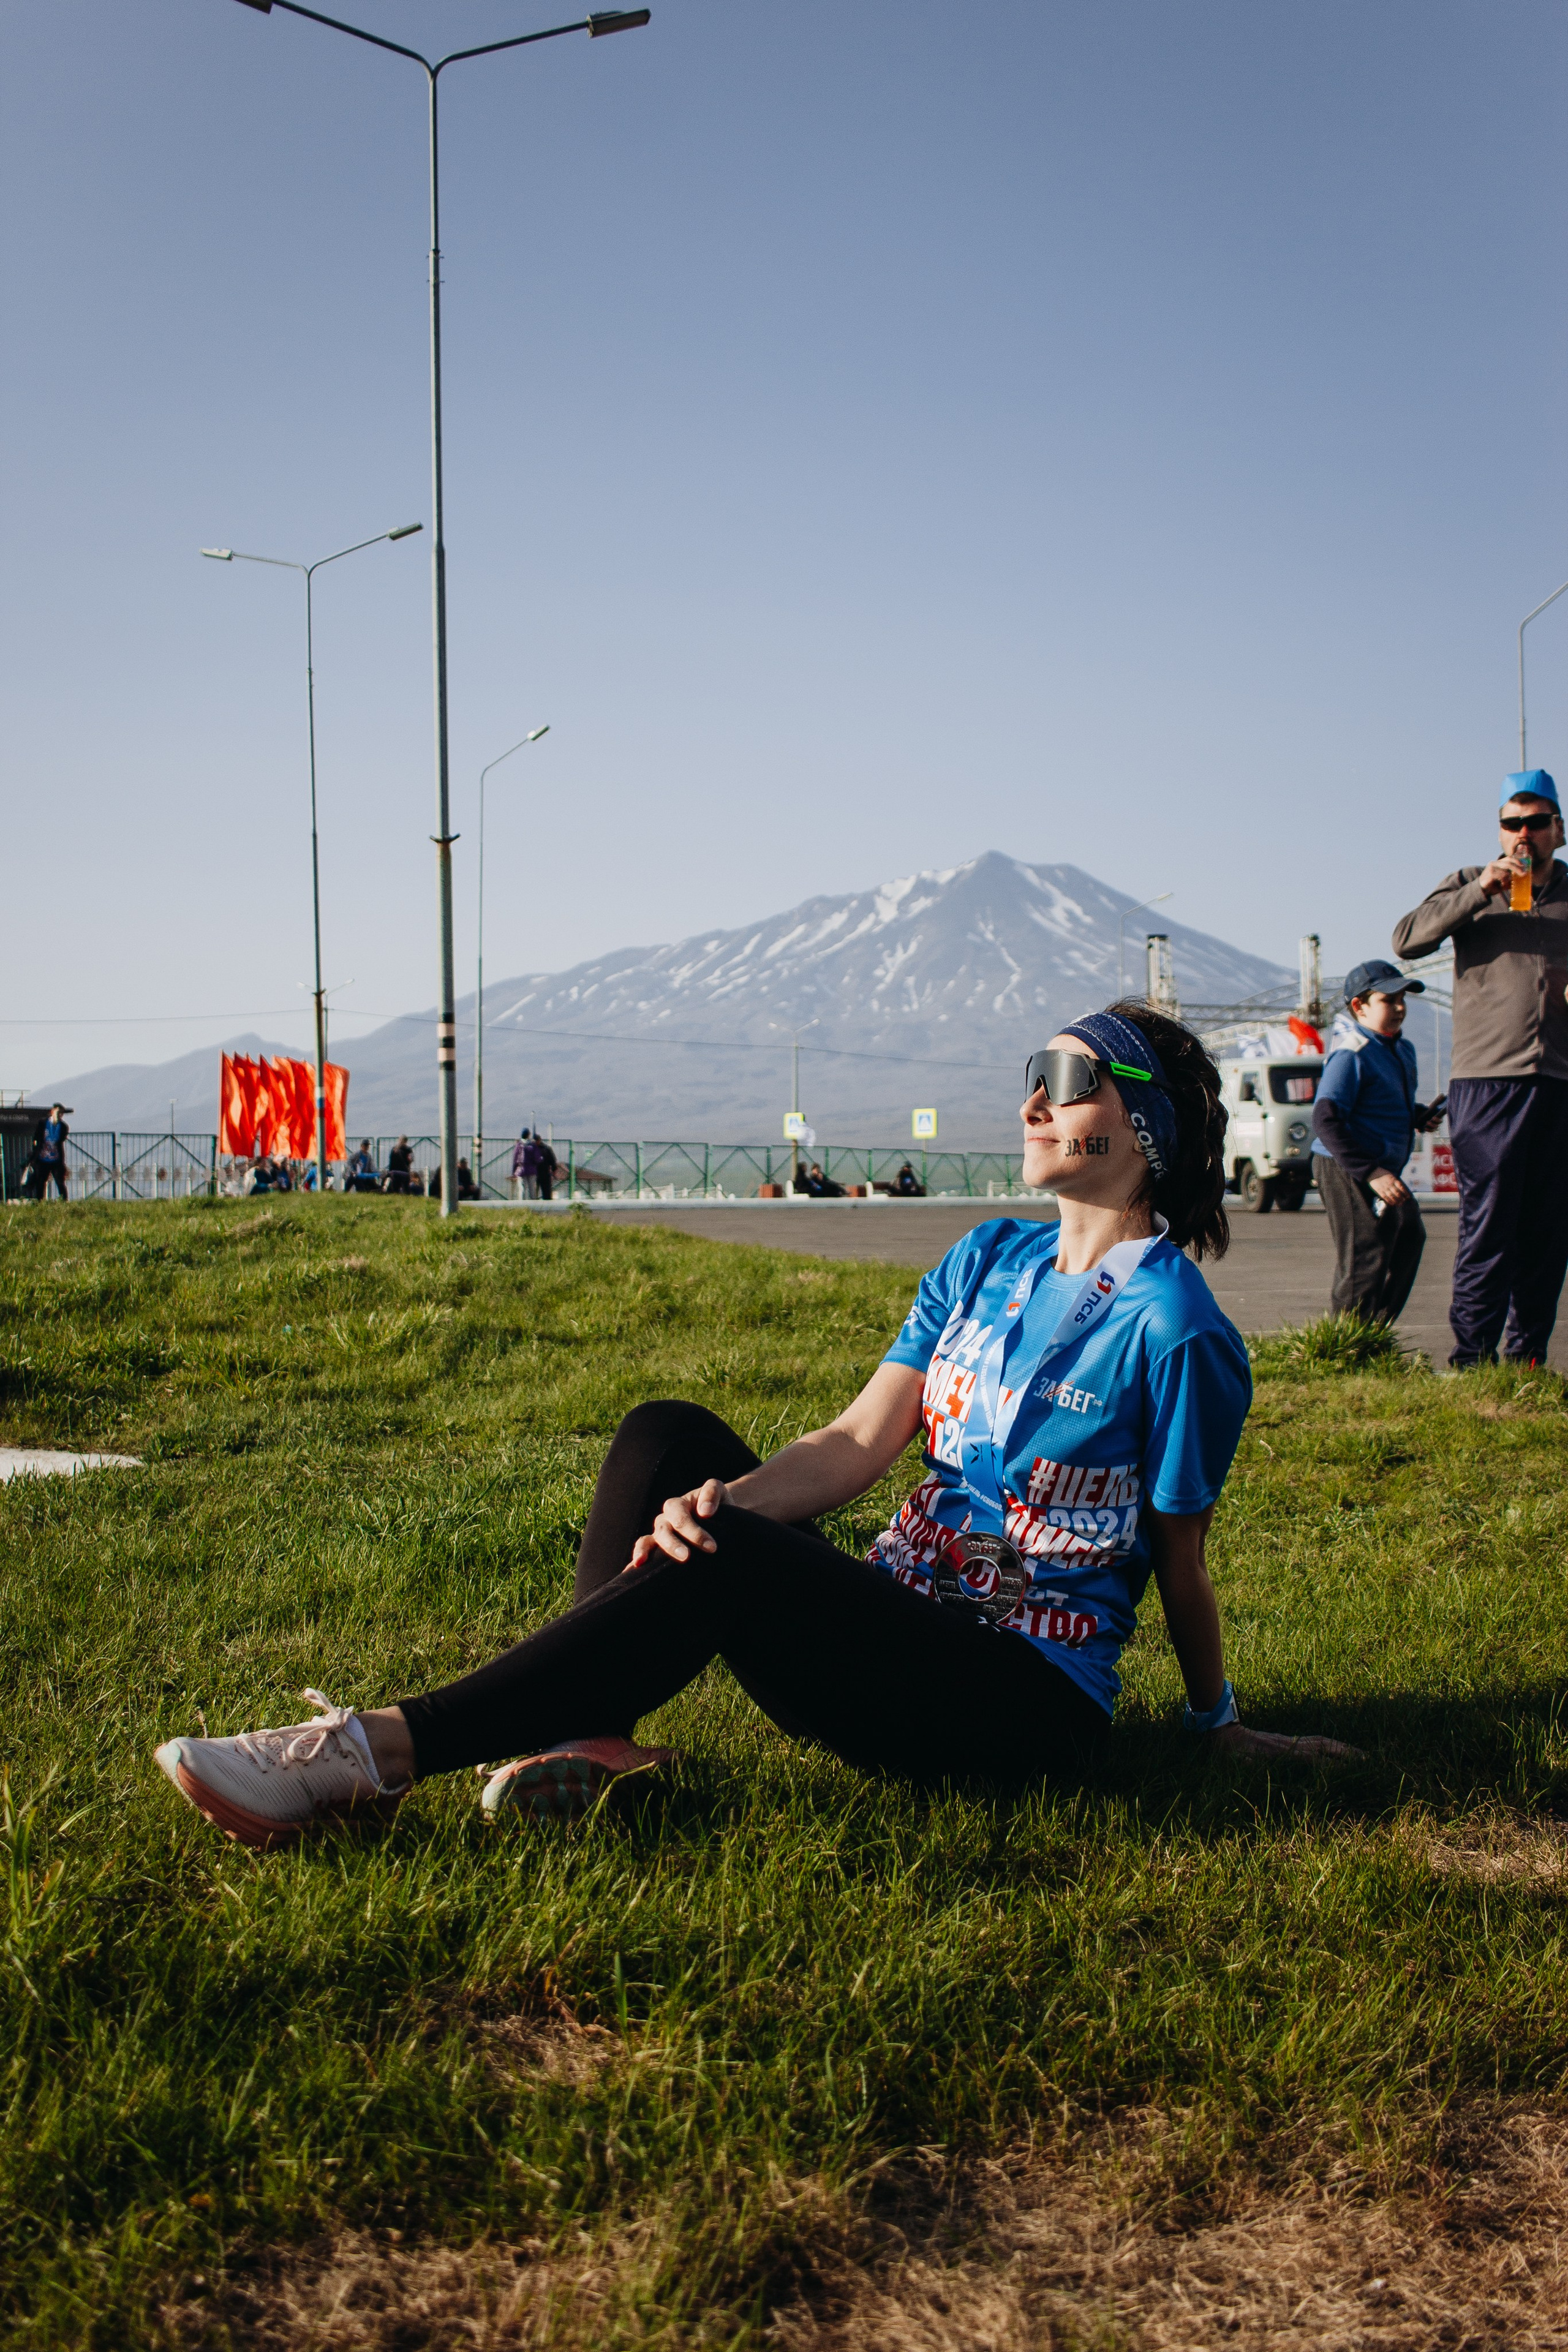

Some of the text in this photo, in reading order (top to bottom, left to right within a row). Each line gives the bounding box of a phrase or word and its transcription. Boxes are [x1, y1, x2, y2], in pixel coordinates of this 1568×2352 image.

[1074, 1291, 1102, 1324] ПСБ
[1027, 1457, 1140, 1509] #ЦЕЛЬ
[980, 1494, 1003, 1512] #СВОБОД
